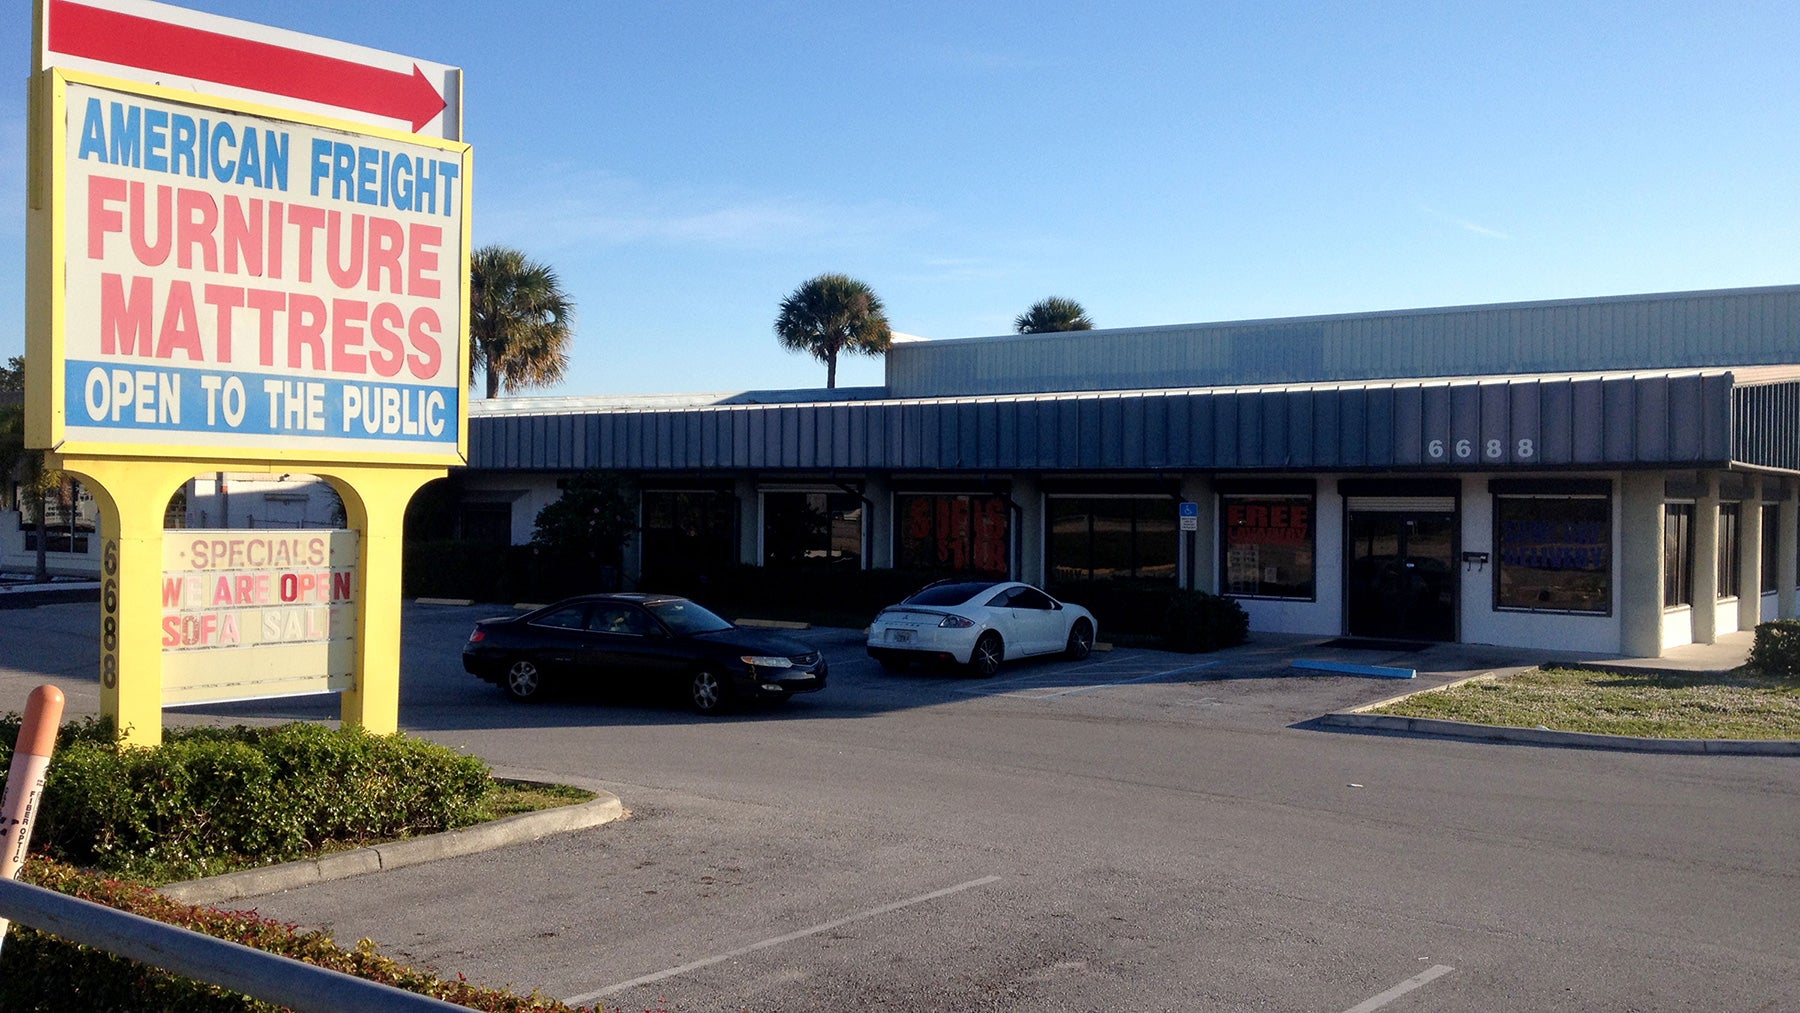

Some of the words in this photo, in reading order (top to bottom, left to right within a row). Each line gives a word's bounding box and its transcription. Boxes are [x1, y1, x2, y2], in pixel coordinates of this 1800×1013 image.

[78, 97, 290, 191] AMERICAN
[311, 138, 459, 216] FREIGHT
[87, 174, 443, 299] FURNITURE
[100, 272, 442, 380] MATTRESS
[84, 366, 181, 425] OPEN
[201, 375, 246, 427] TO
[263, 379, 325, 431] THE
[343, 386, 445, 437] PUBLIC
[1428, 438, 1534, 458] 6688
[1227, 504, 1308, 527] FREE
[190, 538, 325, 569] SPECIALS
[162, 575, 202, 607] WE
[212, 575, 270, 605] ARE
[280, 572, 350, 603] OPEN
[104, 540, 117, 689] 6688
[162, 614, 241, 646] SOFA
[22, 791, 35, 825] FIBER
[13, 828, 26, 862] OPTIC
